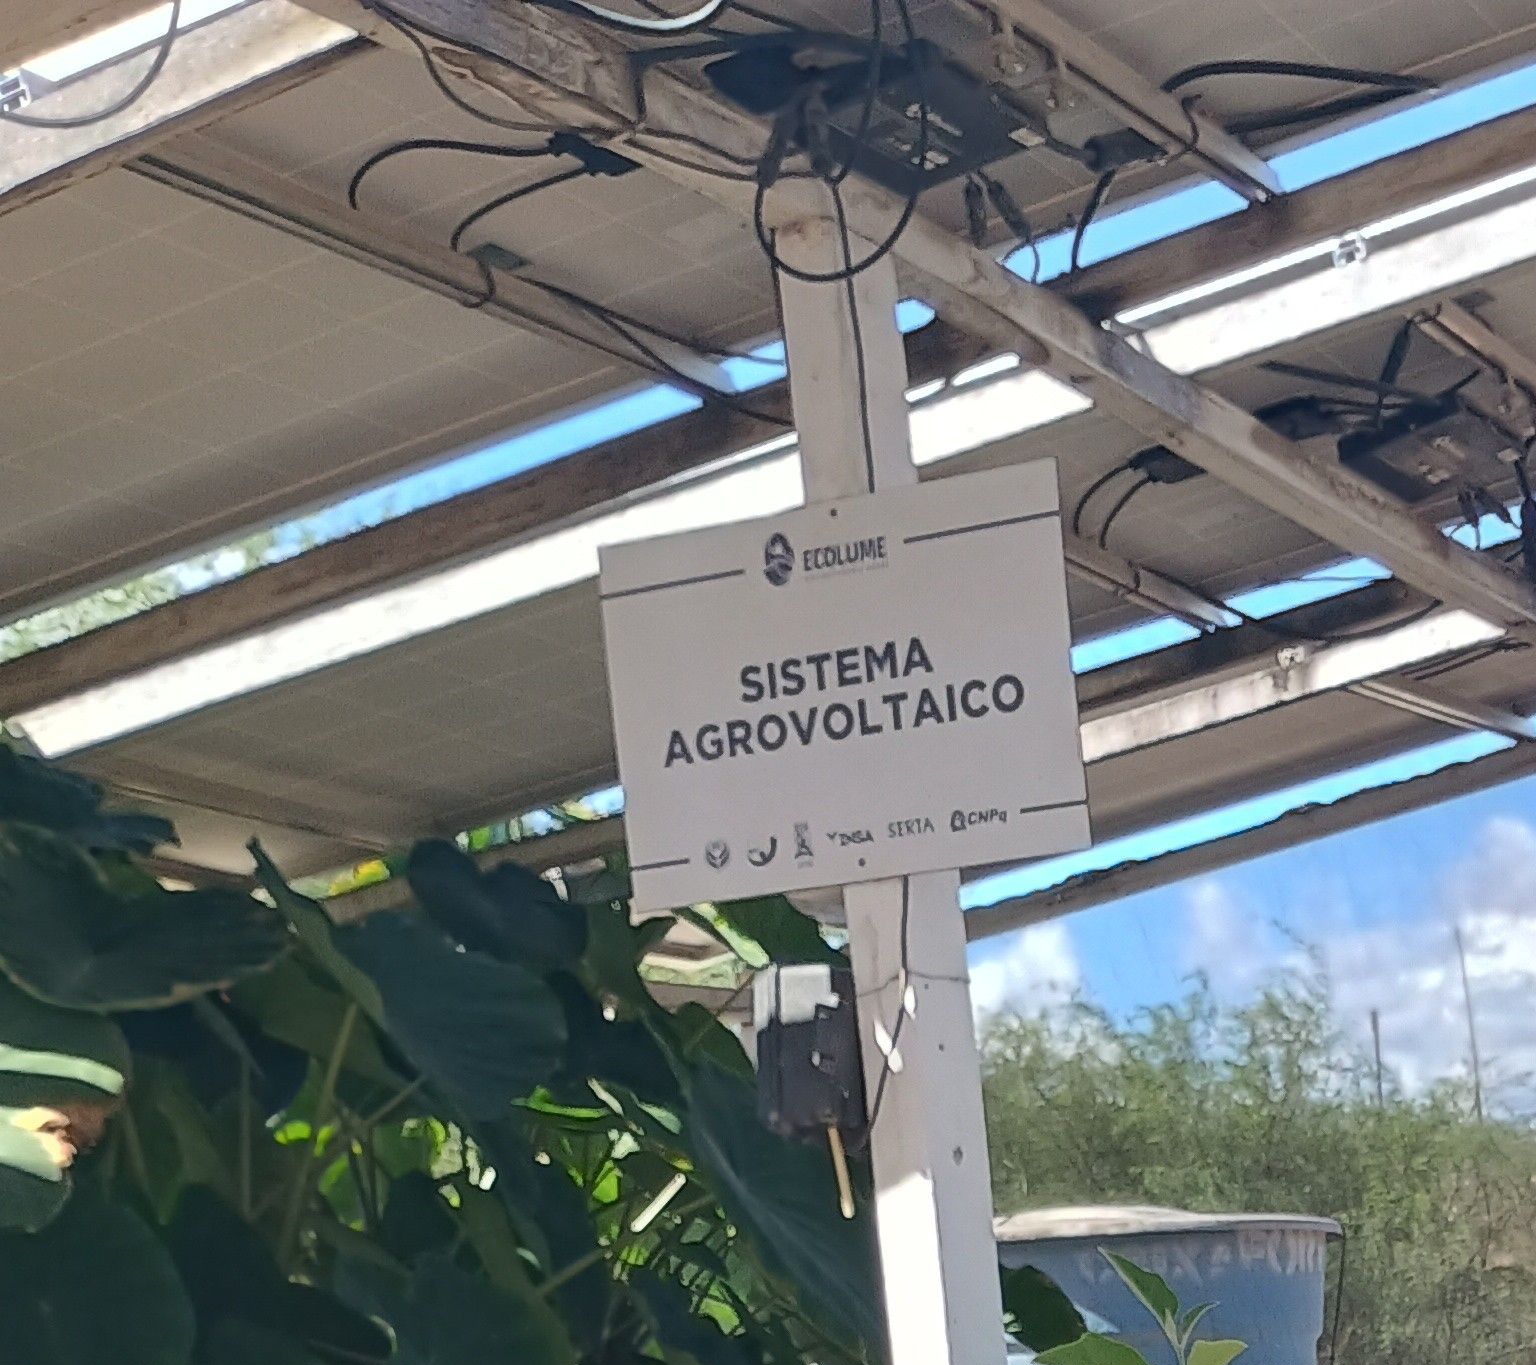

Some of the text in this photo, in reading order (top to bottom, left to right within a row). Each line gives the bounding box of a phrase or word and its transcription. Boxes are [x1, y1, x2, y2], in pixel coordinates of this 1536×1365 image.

[803, 536, 886, 571] ECOLUME
[740, 637, 934, 703] SISTEMA
[663, 674, 1025, 768] AGROVOLTAICO
